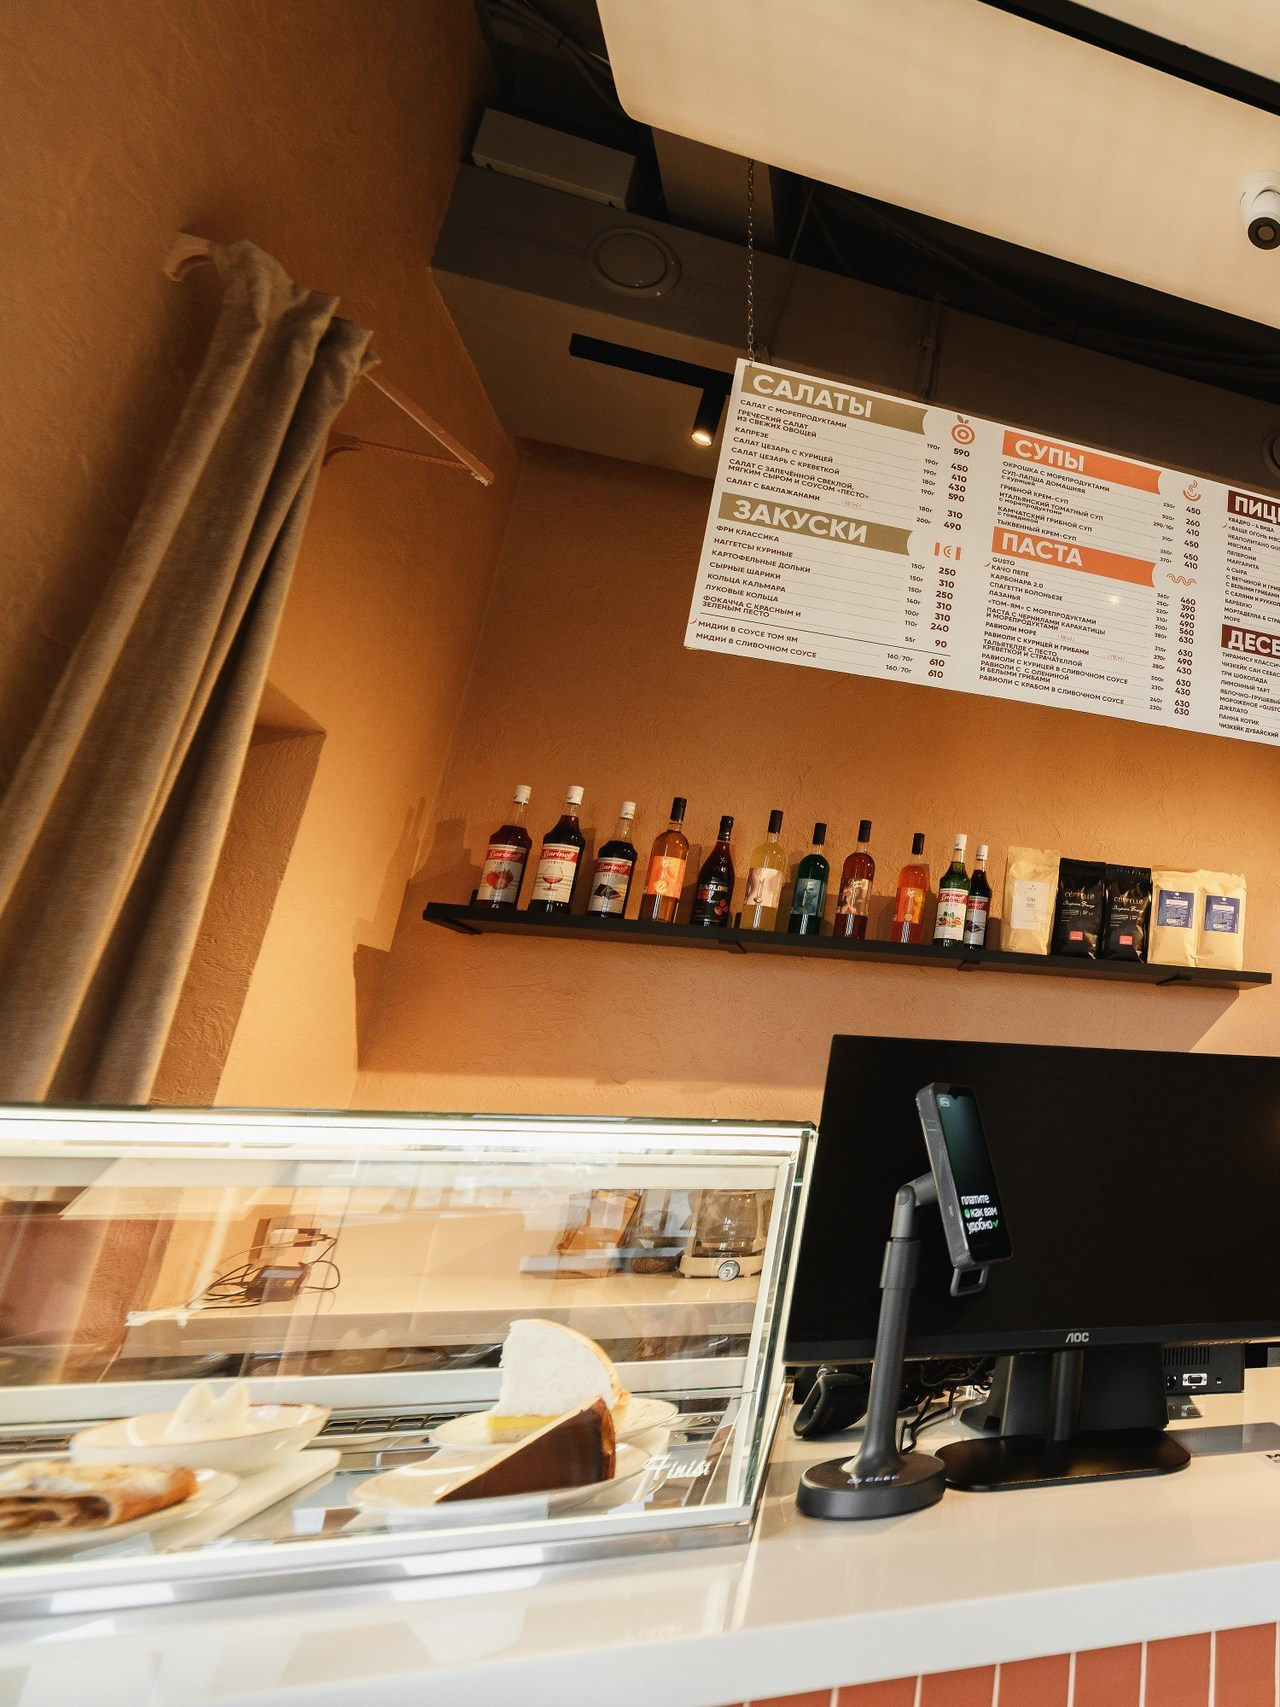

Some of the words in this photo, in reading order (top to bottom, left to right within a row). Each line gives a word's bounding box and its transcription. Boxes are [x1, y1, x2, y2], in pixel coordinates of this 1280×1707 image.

[737, 408, 782, 424] ГРЕЧЕСКИЙ
[782, 419, 809, 430] САЛАТ
[752, 374, 873, 419] САЛАТЫ
[736, 415, 748, 423] ИЗ
[748, 417, 782, 431] СВЕЖИХ
[782, 425, 817, 438] ОВОЩЕЙ
[950, 462, 969, 473] 450
[739, 399, 767, 410] САЛАТ
[775, 407, 847, 429] МОРЕПРОДУКТАМИ
[953, 447, 970, 458] 590
[728, 458, 757, 469] САЛАТ
[730, 446, 759, 458] САЛАТ
[758, 452, 789, 465] ЦЕЗАРЬ
[797, 461, 840, 476] КРЕВЕТКОЙ
[947, 492, 965, 503] 590
[732, 436, 760, 447] САЛАТ
[760, 442, 791, 454] ЦЕЗАРЬ
[798, 450, 834, 464] КУРИЦЕЙ
[948, 482, 966, 493] 430
[734, 426, 769, 439] КАПРЕЗЕ
[951, 473, 968, 483] 410
[1014, 439, 1085, 472] СУПЫ
[725, 476, 753, 487] САЛАТ
[760, 483, 821, 502] БАКЛАЖАНАМИ
[943, 520, 962, 531] 490
[727, 464, 762, 477] МЯГКИМ
[762, 472, 793, 483] СЫРОМ
[801, 480, 836, 493] СОУСОМ
[947, 509, 963, 520] 310
[1000, 483, 1033, 496] ГРИБНОЙ
[1186, 528, 1200, 537] 410
[1002, 461, 1039, 475] ОКРОШКА
[1046, 471, 1110, 493] МОРЕПРОДУКТАМИ
[1185, 506, 1202, 516] 450
[732, 499, 868, 544] ЗАКУСКИ
[996, 518, 1041, 534] ТЫКВЕННЫЙ
[1184, 560, 1198, 570] 410
[713, 537, 755, 551] НАГГЕТСЫ
[755, 545, 794, 559] КУРИНЫЕ
[938, 578, 955, 589] 310
[716, 525, 735, 534] ФРИ
[735, 528, 780, 543] КЛАССИКА
[938, 566, 957, 577] 250
[1001, 532, 1083, 567] ПАСТА
[1226, 557, 1260, 570] МАРГАРИТА
[707, 572, 741, 585] КОЛЬЦА
[742, 579, 786, 593] КАЛЬМАРА
[934, 612, 951, 622] 310
[709, 561, 746, 574] СЫРНЫЕ
[746, 568, 781, 580] ШАРИКИ
[936, 601, 953, 611] 310
[711, 549, 777, 567] КАРТОФЕЛЬНЫЕ
[777, 561, 811, 574] ДОЛЬКИ
[935, 590, 954, 600] 250
[990, 573, 1032, 587] КАРБОНАРА
[1032, 581, 1044, 589] 2.0
[1179, 611, 1196, 621] 490
[991, 556, 1016, 567] GUSTO
[1180, 596, 1197, 606] 460
[991, 564, 1012, 574] КАЧО
[1012, 568, 1030, 578] ПЕПЕ
[1180, 603, 1196, 614] 390
[702, 595, 744, 608] ФОКАЧЧА
[753, 603, 794, 616] КРАСНЫМ
[704, 583, 745, 597] ЛУКОВЫЕ
[745, 591, 779, 603] КОЛЬЦА
[930, 622, 950, 633] 240
[742, 607, 770, 618] ПЕСТО
[934, 639, 948, 649] 90
[988, 589, 1021, 601] ЛАЗАНЬЯ
[1179, 627, 1195, 637] 560
[989, 581, 1024, 594] СПАГЕТТИ
[1024, 588, 1063, 602] БОЛОНЬЕЗЕ
[1179, 619, 1195, 629] 490
[695, 632, 727, 643] МИДИИ
[728, 637, 734, 645] В
[735, 639, 789, 654] СЛИВОЧНОМ
[789, 648, 817, 659] СОУСЕ
[927, 669, 944, 679] 610
[697, 620, 729, 632] МИДИИ
[737, 627, 766, 638] СОУСЕ
[767, 632, 785, 641] ТОМ
[785, 635, 799, 644] ЯМ
[928, 658, 946, 668] 610
[985, 621, 1017, 633] РАВИОЛИ
[1017, 627, 1037, 636] МОРЕ
[1177, 657, 1193, 667] 490
[1233, 672, 1268, 685] ШОКОЛАДА
[1218, 704, 1249, 715] ДЖЕЛАТО
[960, 1194, 990, 1206] платите
[969, 1208, 984, 1218] как
[984, 1206, 998, 1217] вам
[966, 1217, 993, 1235] удобно
[1065, 1332, 1090, 1344] AOC
